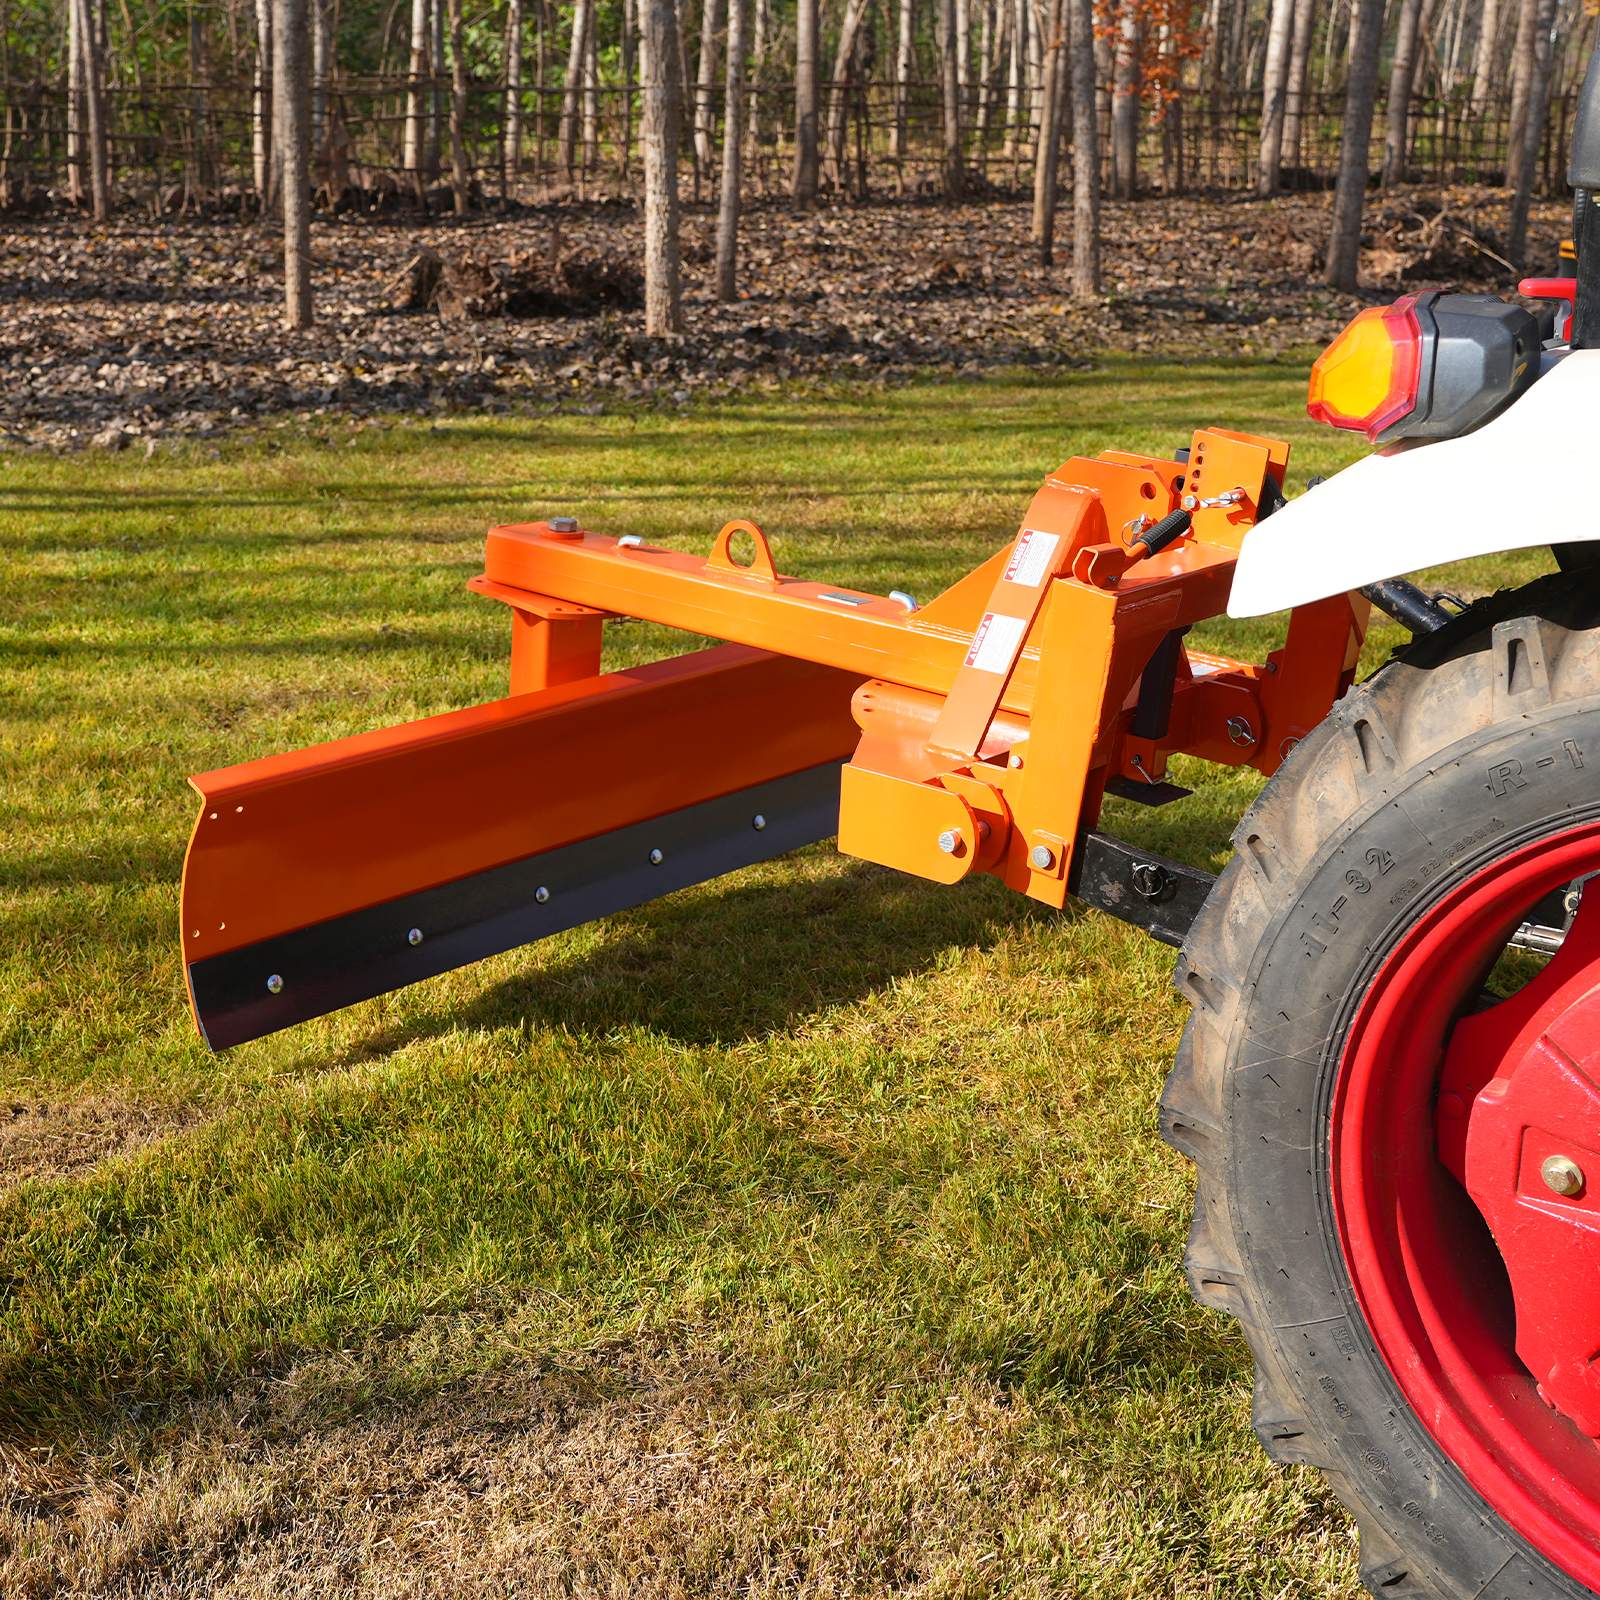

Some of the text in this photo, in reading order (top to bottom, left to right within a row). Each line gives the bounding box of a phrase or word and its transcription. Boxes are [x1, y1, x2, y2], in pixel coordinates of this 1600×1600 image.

[1010, 542, 1028, 569] DANGER
[971, 626, 988, 653] CAUTION
[1487, 738, 1584, 798] R-1
[1299, 846, 1396, 958] 11-32
